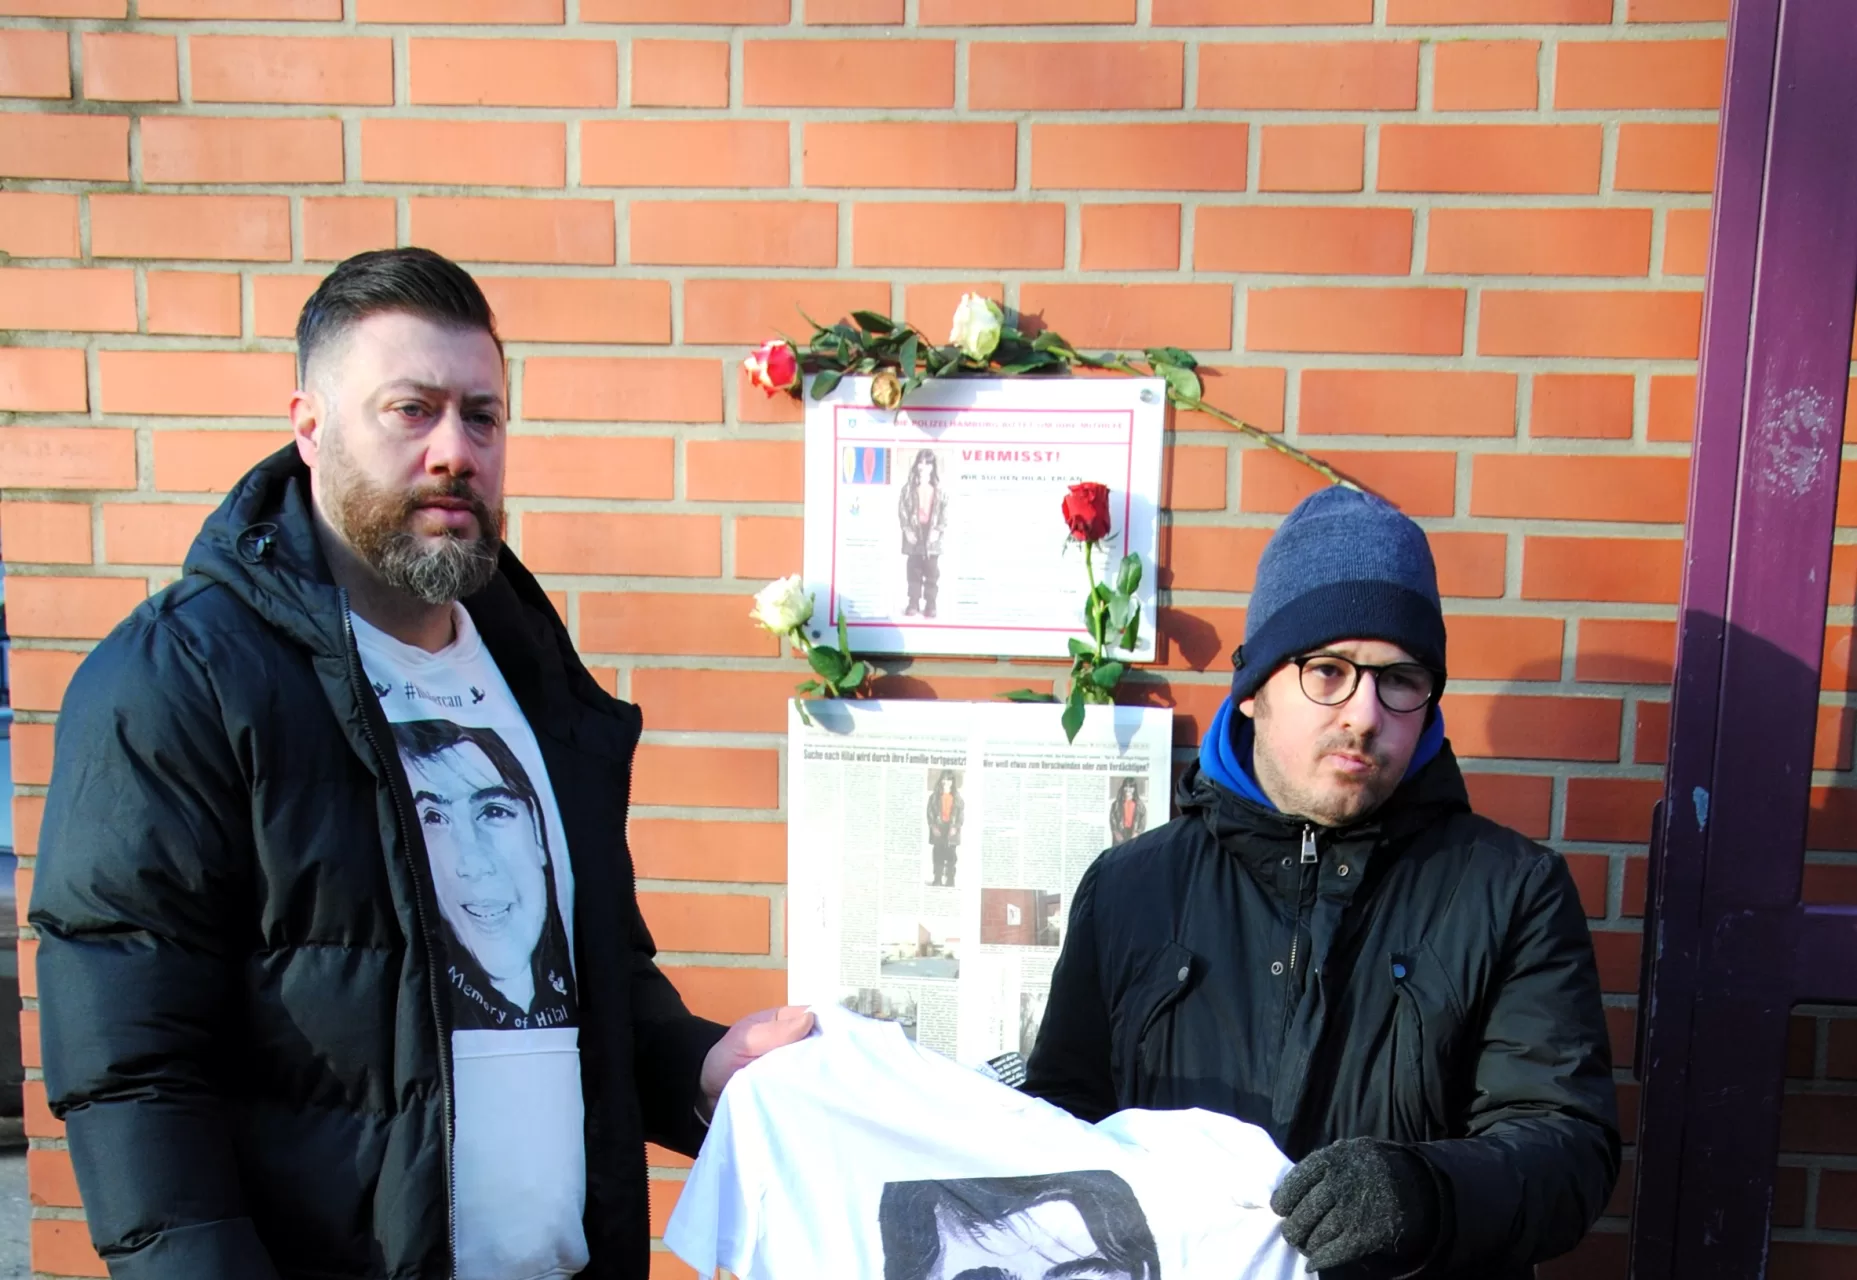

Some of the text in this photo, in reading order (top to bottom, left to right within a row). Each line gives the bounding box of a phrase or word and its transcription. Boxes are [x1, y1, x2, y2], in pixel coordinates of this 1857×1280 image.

[962, 449, 1061, 463] VERMISST!
[803, 748, 967, 767] Suche nach Hilal wird durch ihre Familie fortgesetzt
[448, 965, 568, 1029] Memory of Hilal
